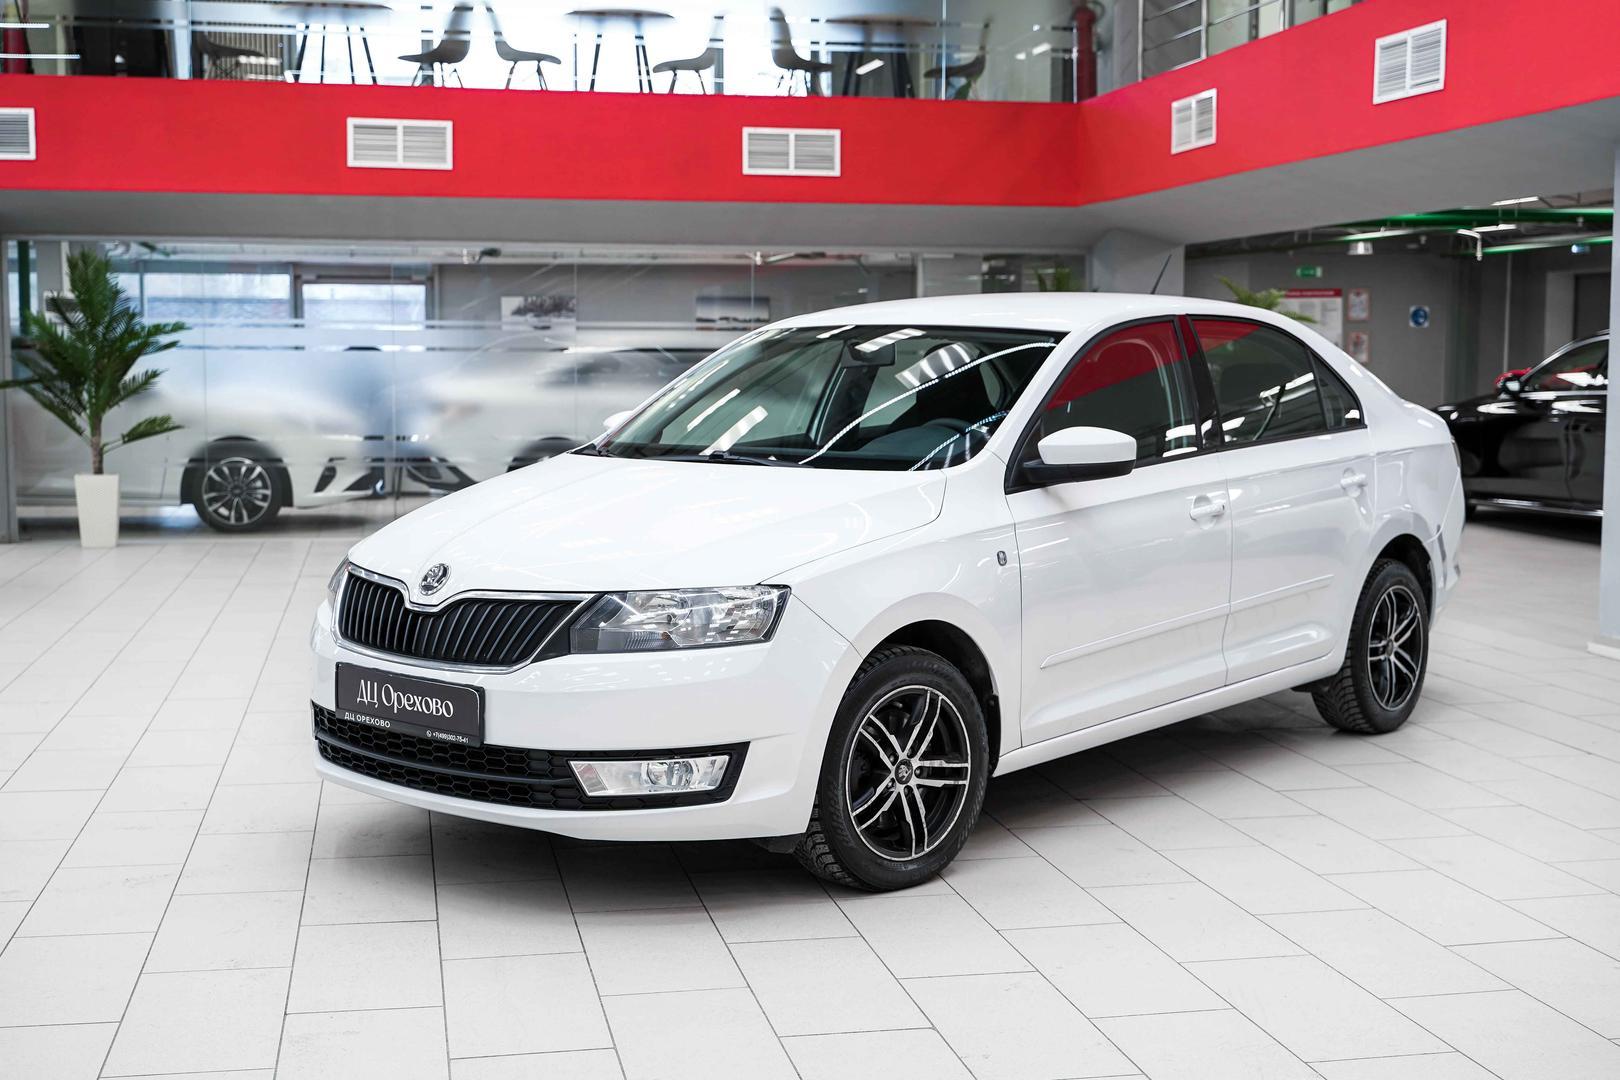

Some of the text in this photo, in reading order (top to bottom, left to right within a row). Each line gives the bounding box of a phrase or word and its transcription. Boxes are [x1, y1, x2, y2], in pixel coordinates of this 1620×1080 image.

[357, 679, 454, 718] ДЦ Орехово
[344, 711, 391, 728] ДЦ ОРЕХОВО
